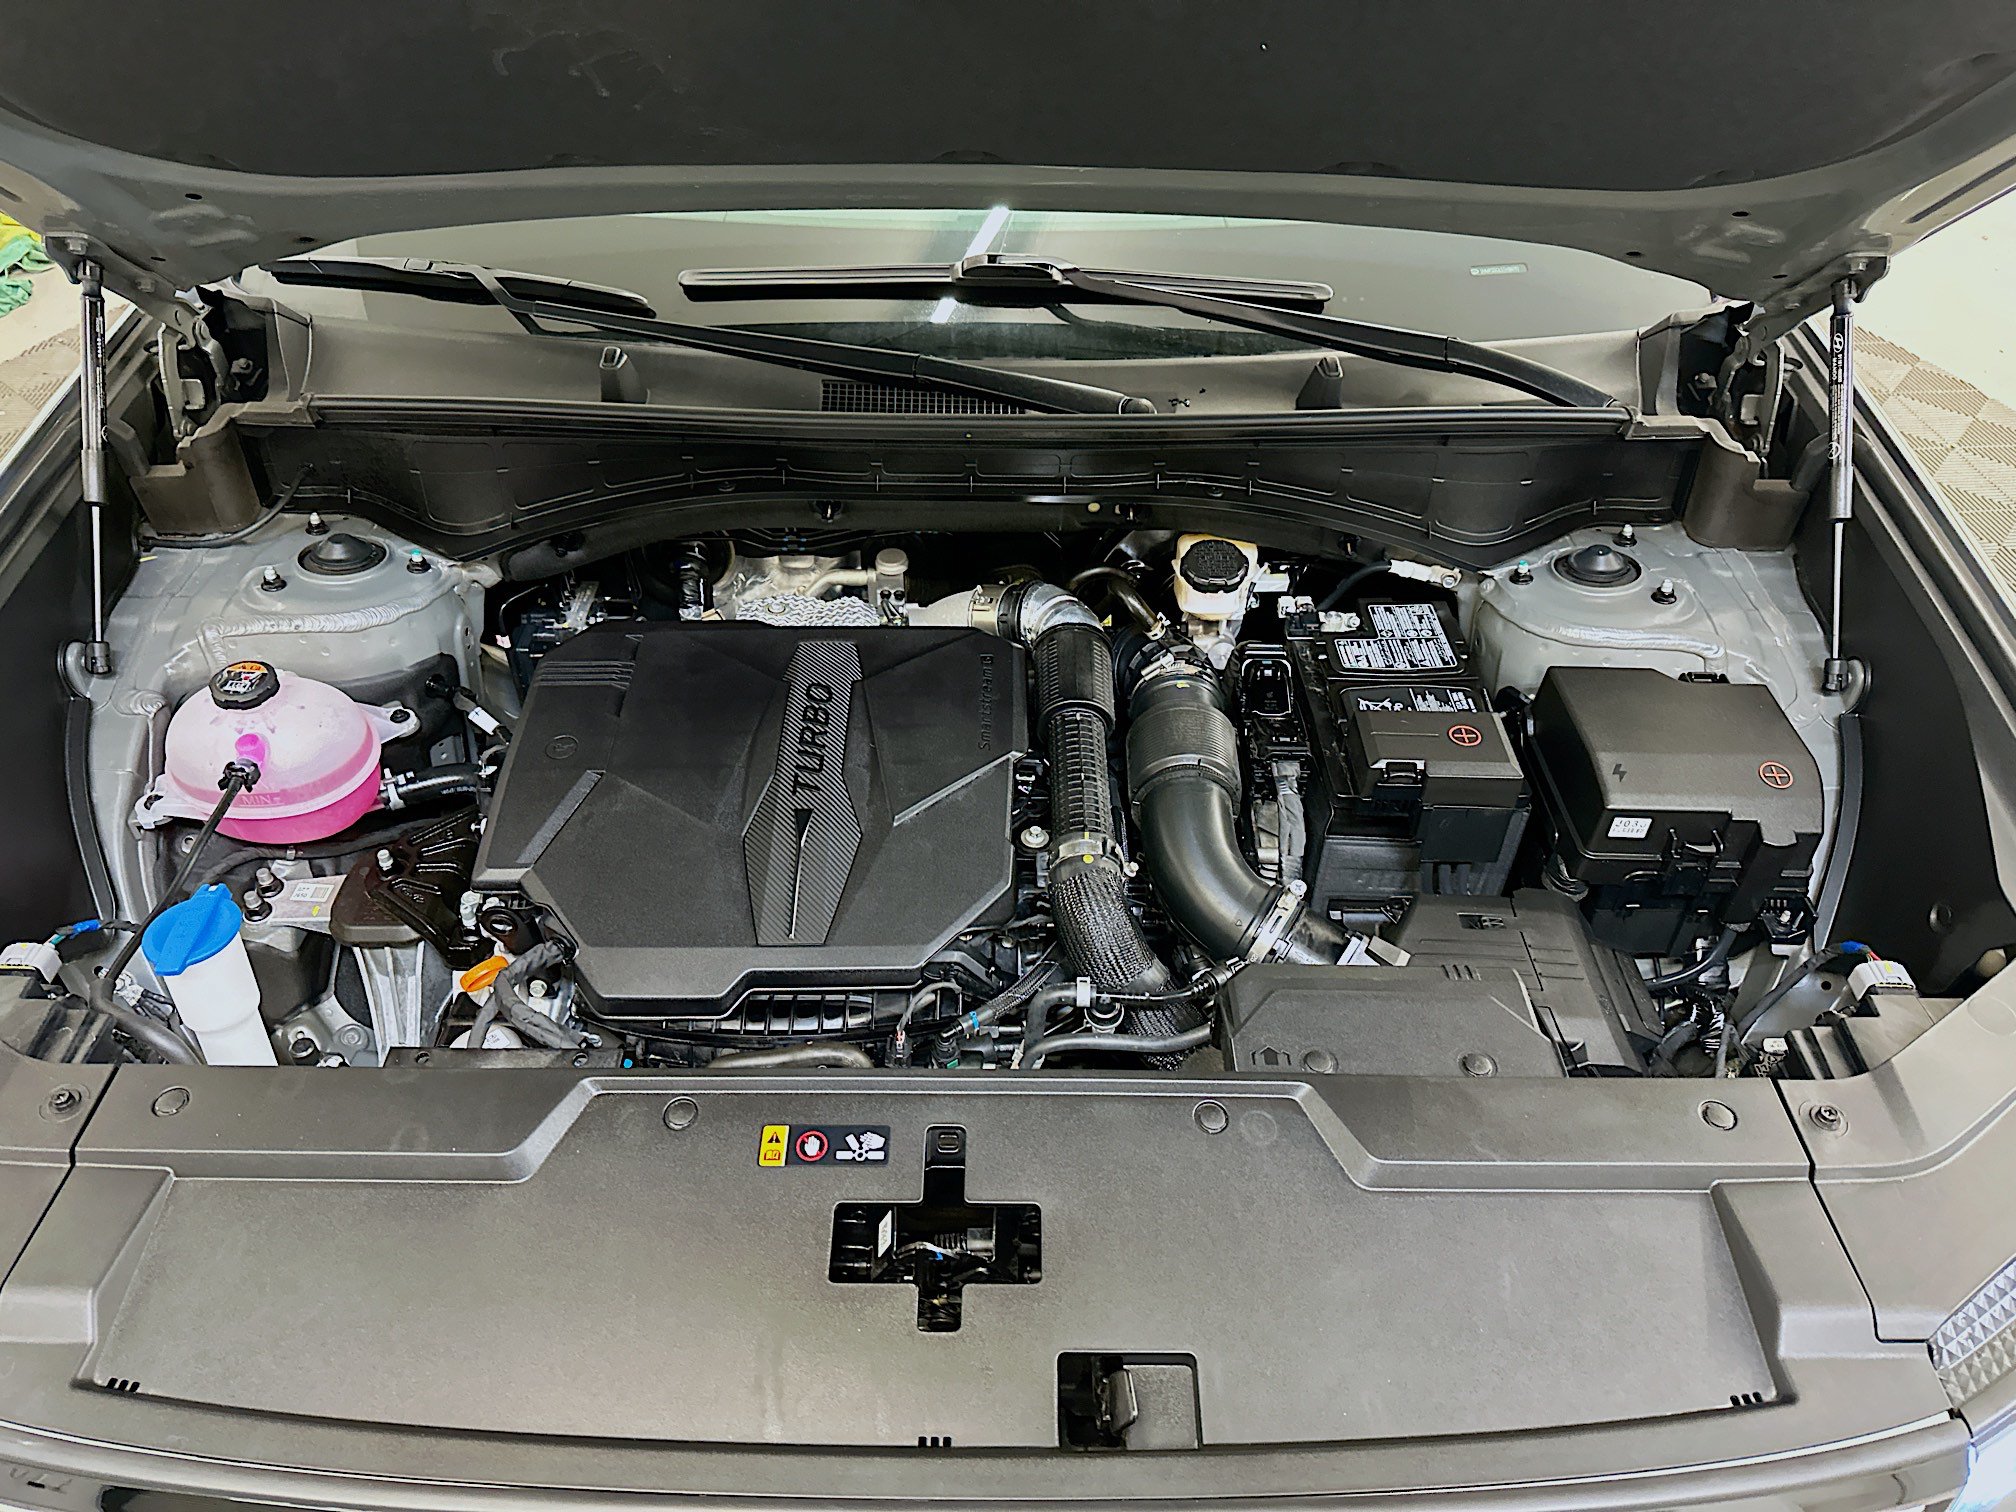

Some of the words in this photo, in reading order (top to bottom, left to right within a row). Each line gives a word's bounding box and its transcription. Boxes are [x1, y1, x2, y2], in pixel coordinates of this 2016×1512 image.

[791, 681, 834, 796] TURBO
[977, 666, 994, 752] Smartstream
[241, 794, 271, 806] MIN
